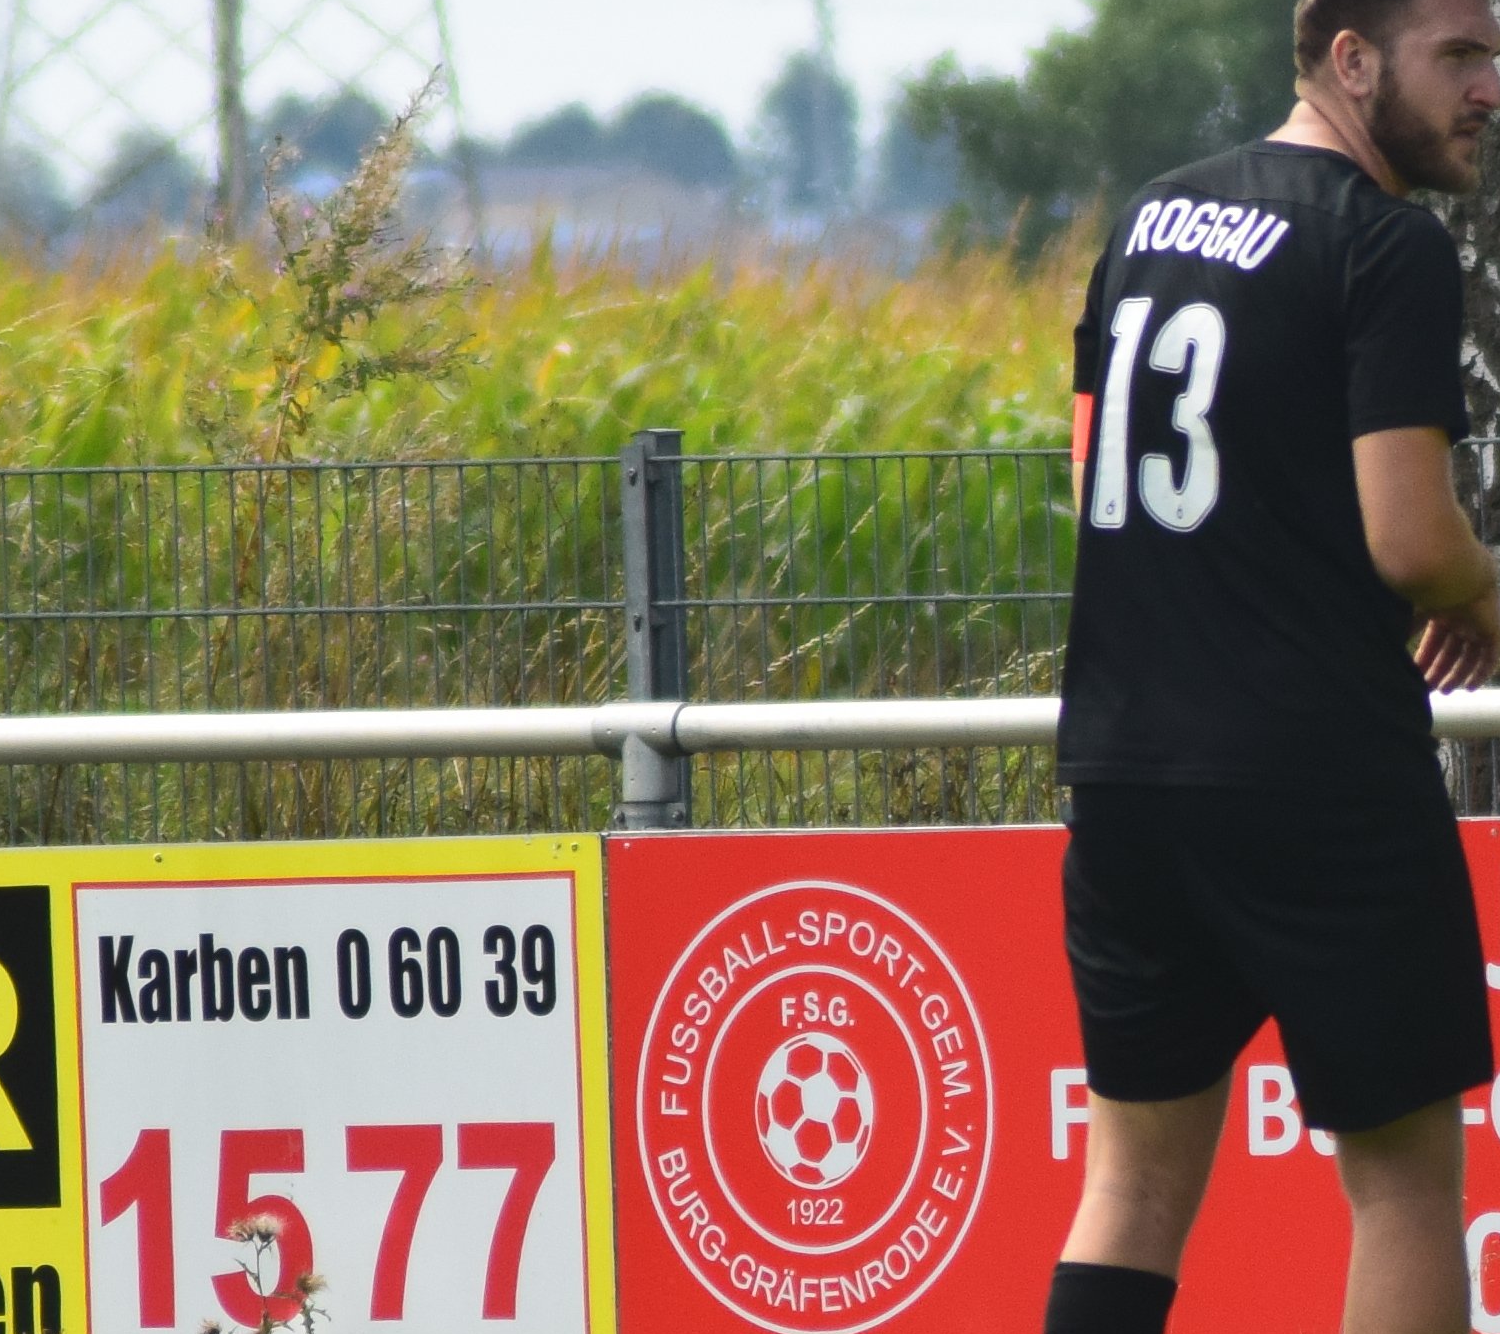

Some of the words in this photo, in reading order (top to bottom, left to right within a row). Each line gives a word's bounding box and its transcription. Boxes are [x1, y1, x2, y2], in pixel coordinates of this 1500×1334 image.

[1125, 198, 1289, 269] ROGGAU
[1090, 297, 1226, 533] 13
[100, 933, 309, 1025] Karben
[660, 909, 973, 1117] FUSSBALL-SPORT-GEM.
[781, 991, 855, 1030] F.S.G.
[100, 1121, 557, 1330] 1577
[657, 1146, 948, 1314] BURG-GRÄFENRODE
[931, 1123, 973, 1203] E.V.
[786, 1199, 844, 1226] 1922
